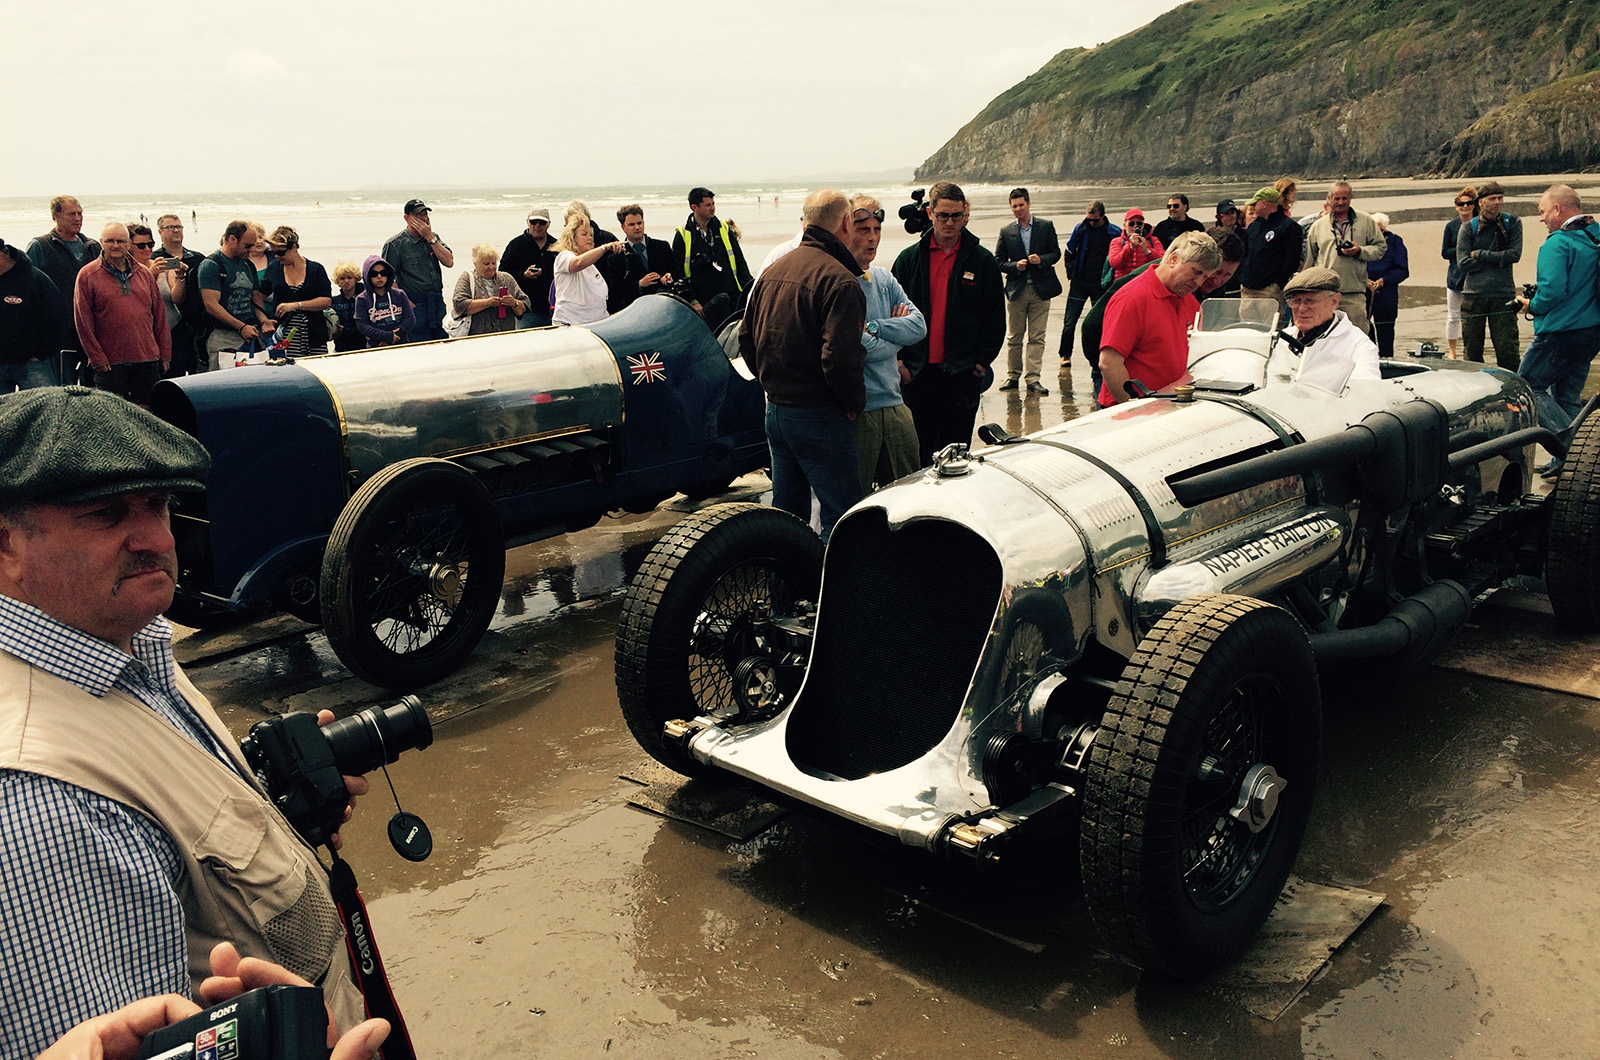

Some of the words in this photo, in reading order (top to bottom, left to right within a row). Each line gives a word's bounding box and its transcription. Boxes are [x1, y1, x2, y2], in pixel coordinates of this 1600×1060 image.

[1202, 513, 1333, 577] NAPIER-RAILTON
[351, 911, 374, 975] Canon
[209, 1003, 238, 1021] SONY
